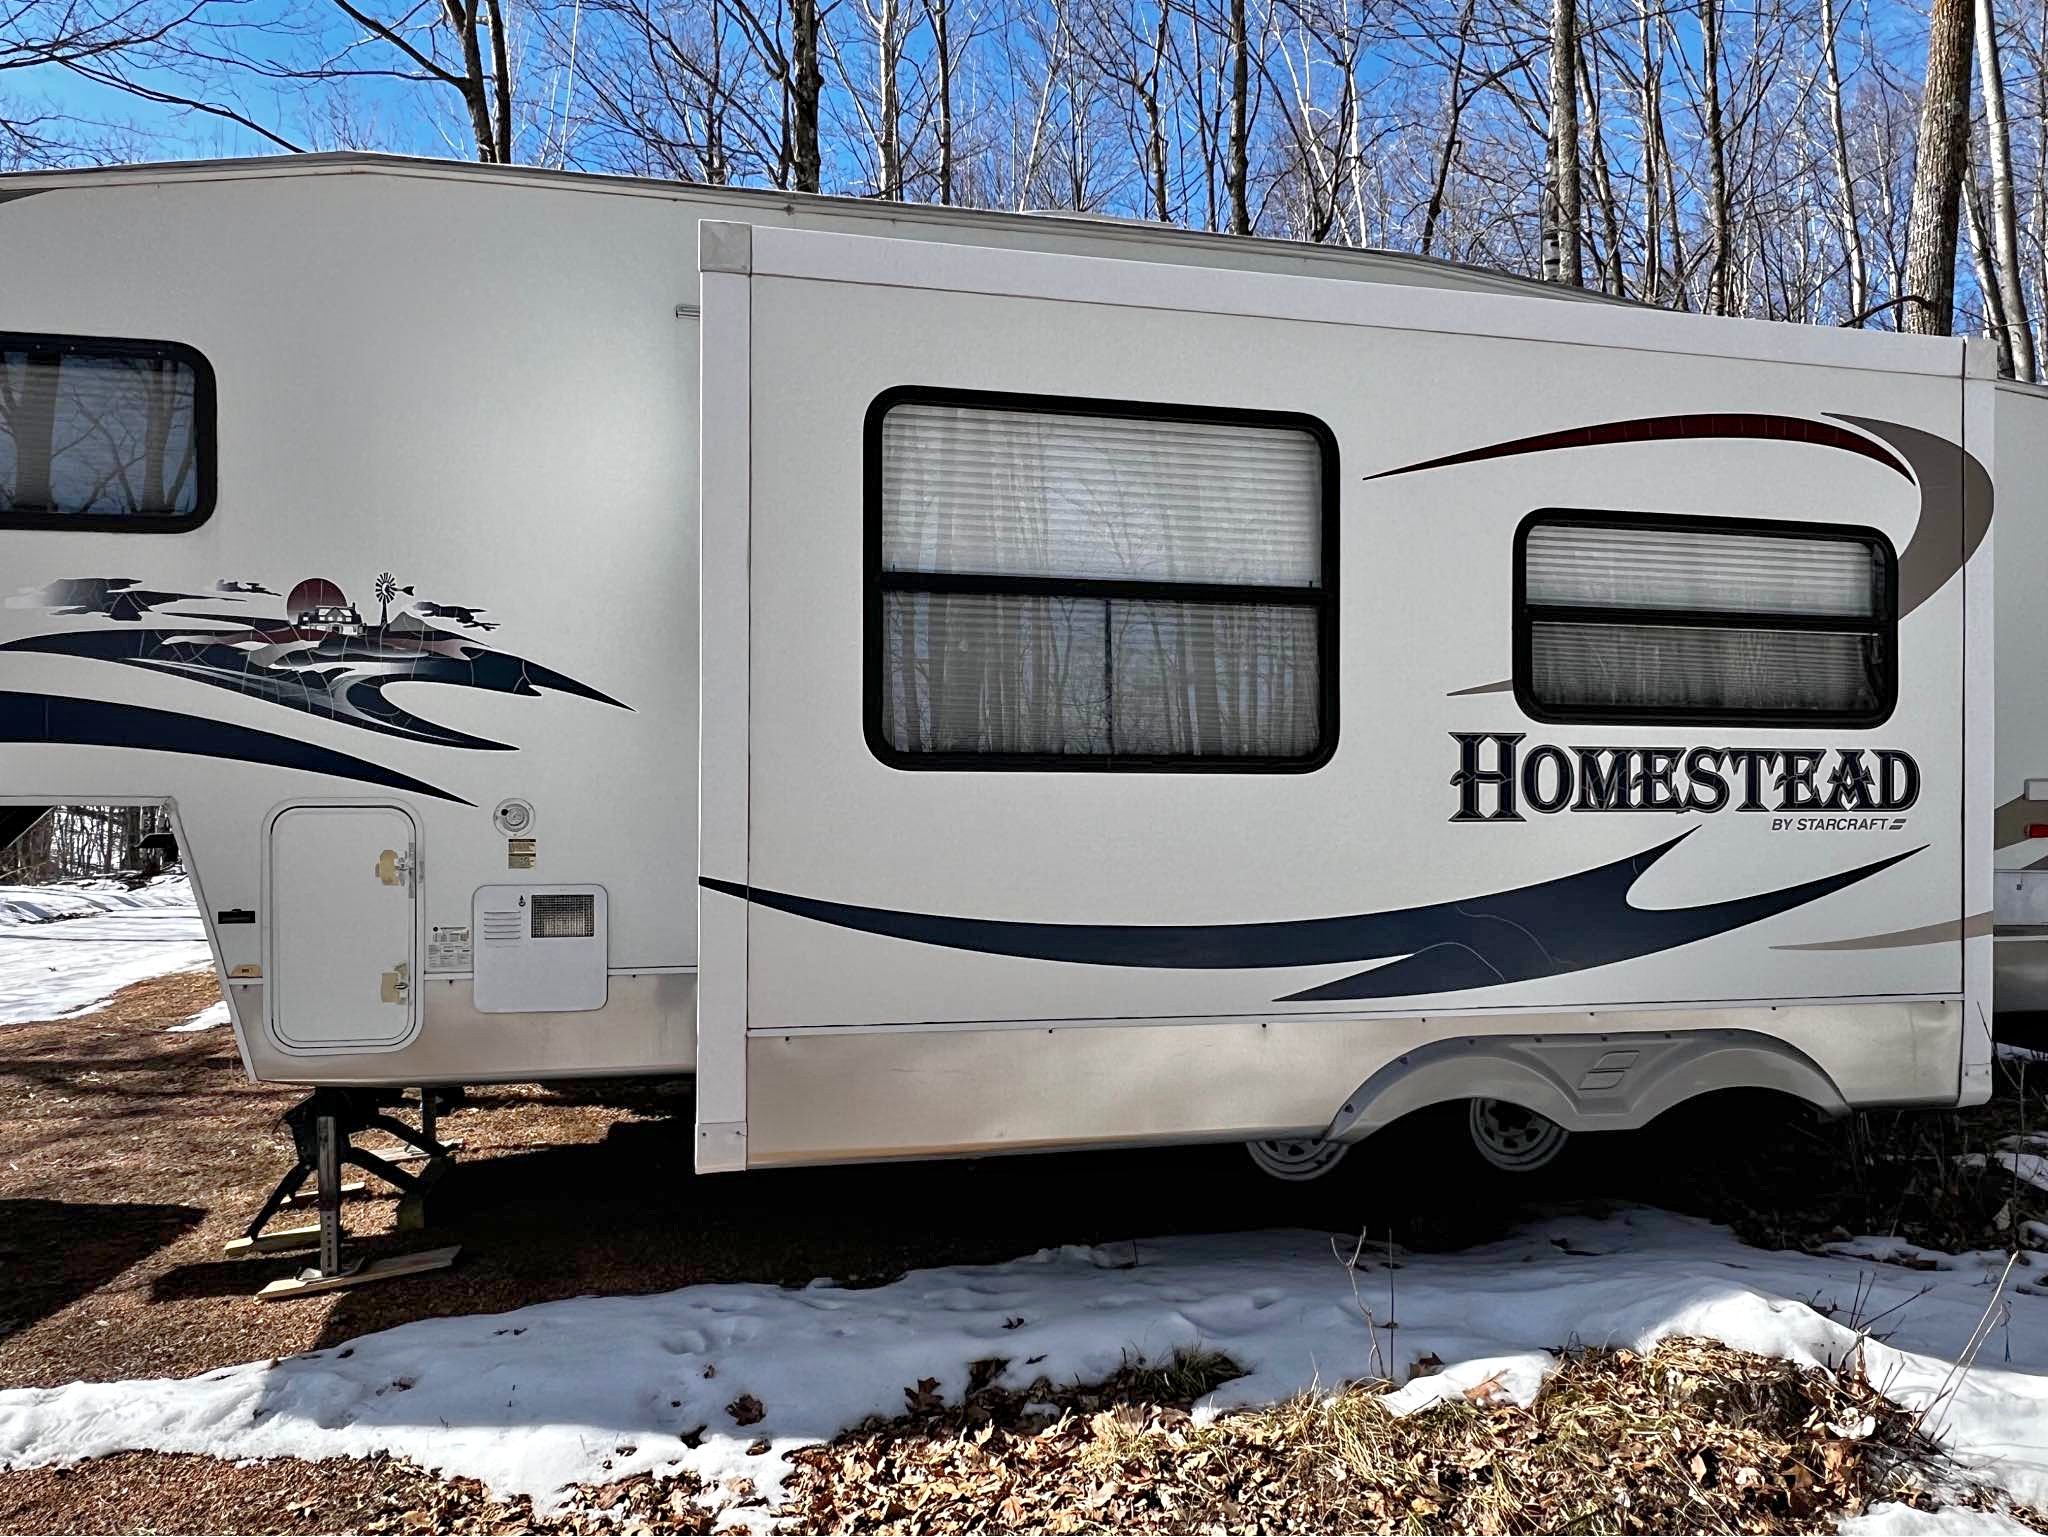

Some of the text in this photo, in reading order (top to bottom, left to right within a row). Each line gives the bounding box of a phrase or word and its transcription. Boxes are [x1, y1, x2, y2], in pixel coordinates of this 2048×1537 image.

[1448, 732, 1921, 822] HOMESTEAD
[1771, 818, 1889, 831] BY STARCRAFT
